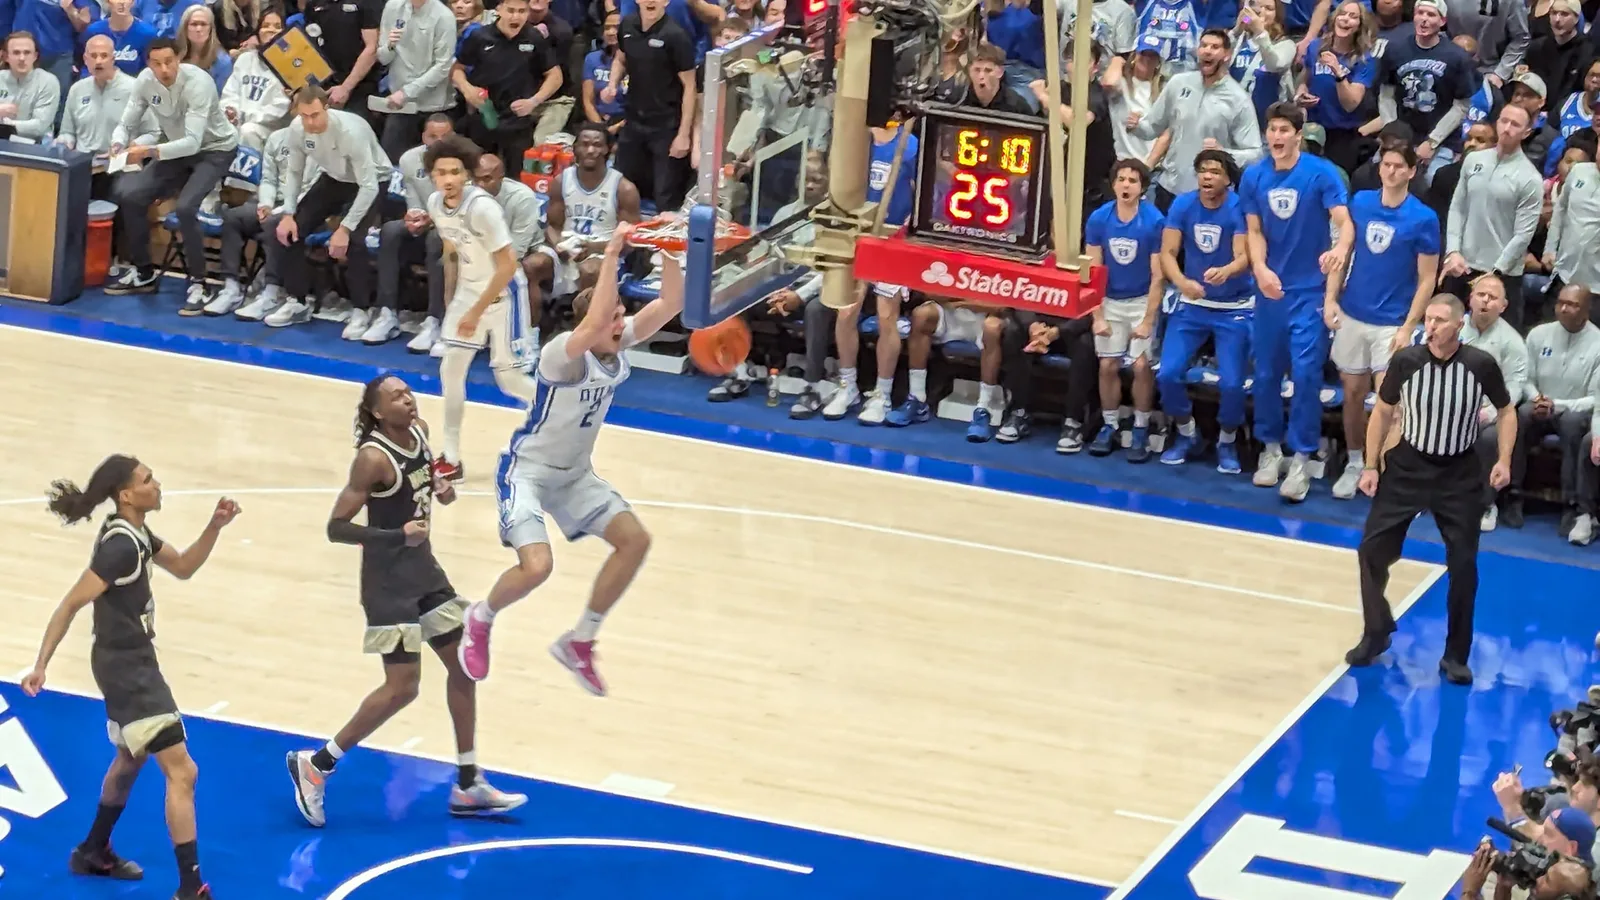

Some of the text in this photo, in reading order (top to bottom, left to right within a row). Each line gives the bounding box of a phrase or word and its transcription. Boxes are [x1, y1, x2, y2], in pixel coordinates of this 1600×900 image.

[958, 130, 1032, 174] 6:10
[949, 172, 1010, 225] 25
[580, 398, 602, 428] 2
